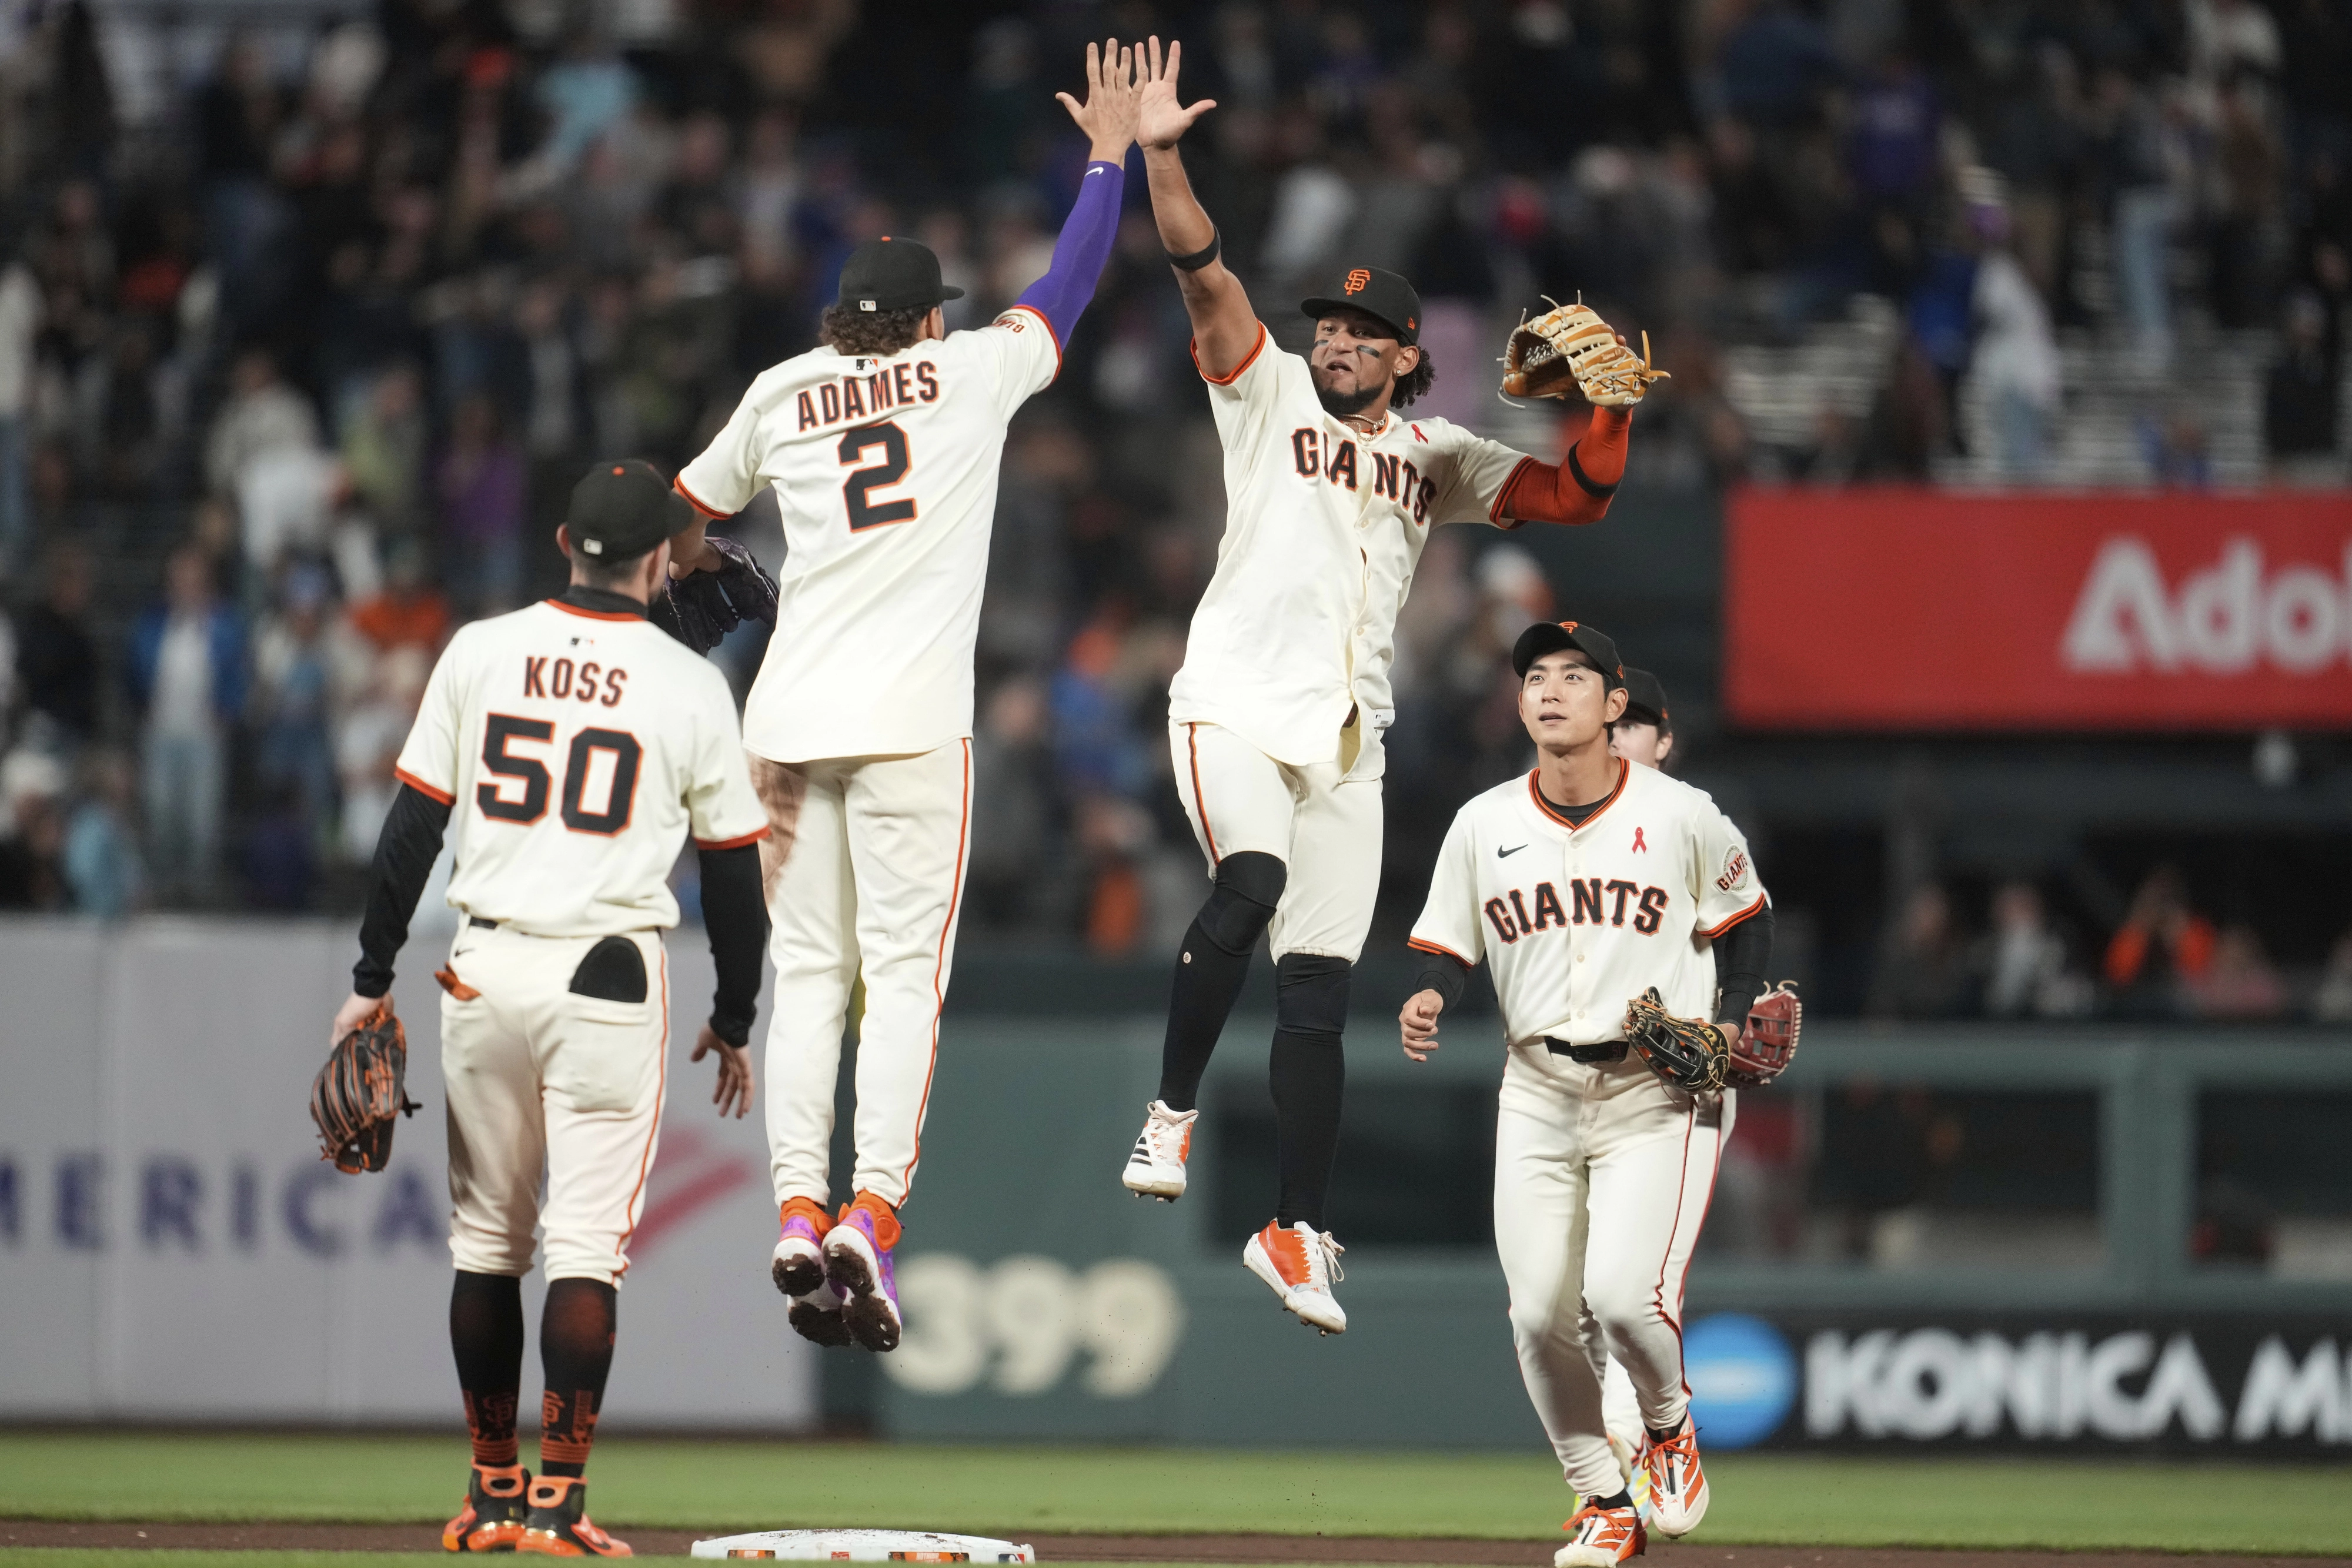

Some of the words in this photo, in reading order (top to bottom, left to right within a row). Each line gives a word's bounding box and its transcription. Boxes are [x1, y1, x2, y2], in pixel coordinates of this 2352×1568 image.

[797, 360, 939, 432] ADAMES
[837, 420, 917, 533] 2
[2063, 536, 2352, 674] Ado
[524, 657, 627, 707] KOSS
[477, 712, 643, 838] 50
[1484, 878, 1670, 945] GIANTS
[1716, 852, 1748, 891] GIANTS
[881, 1254, 1178, 1396] 399
[1804, 1328, 2226, 1440] KONICA
[2233, 1332, 2352, 1444] M
